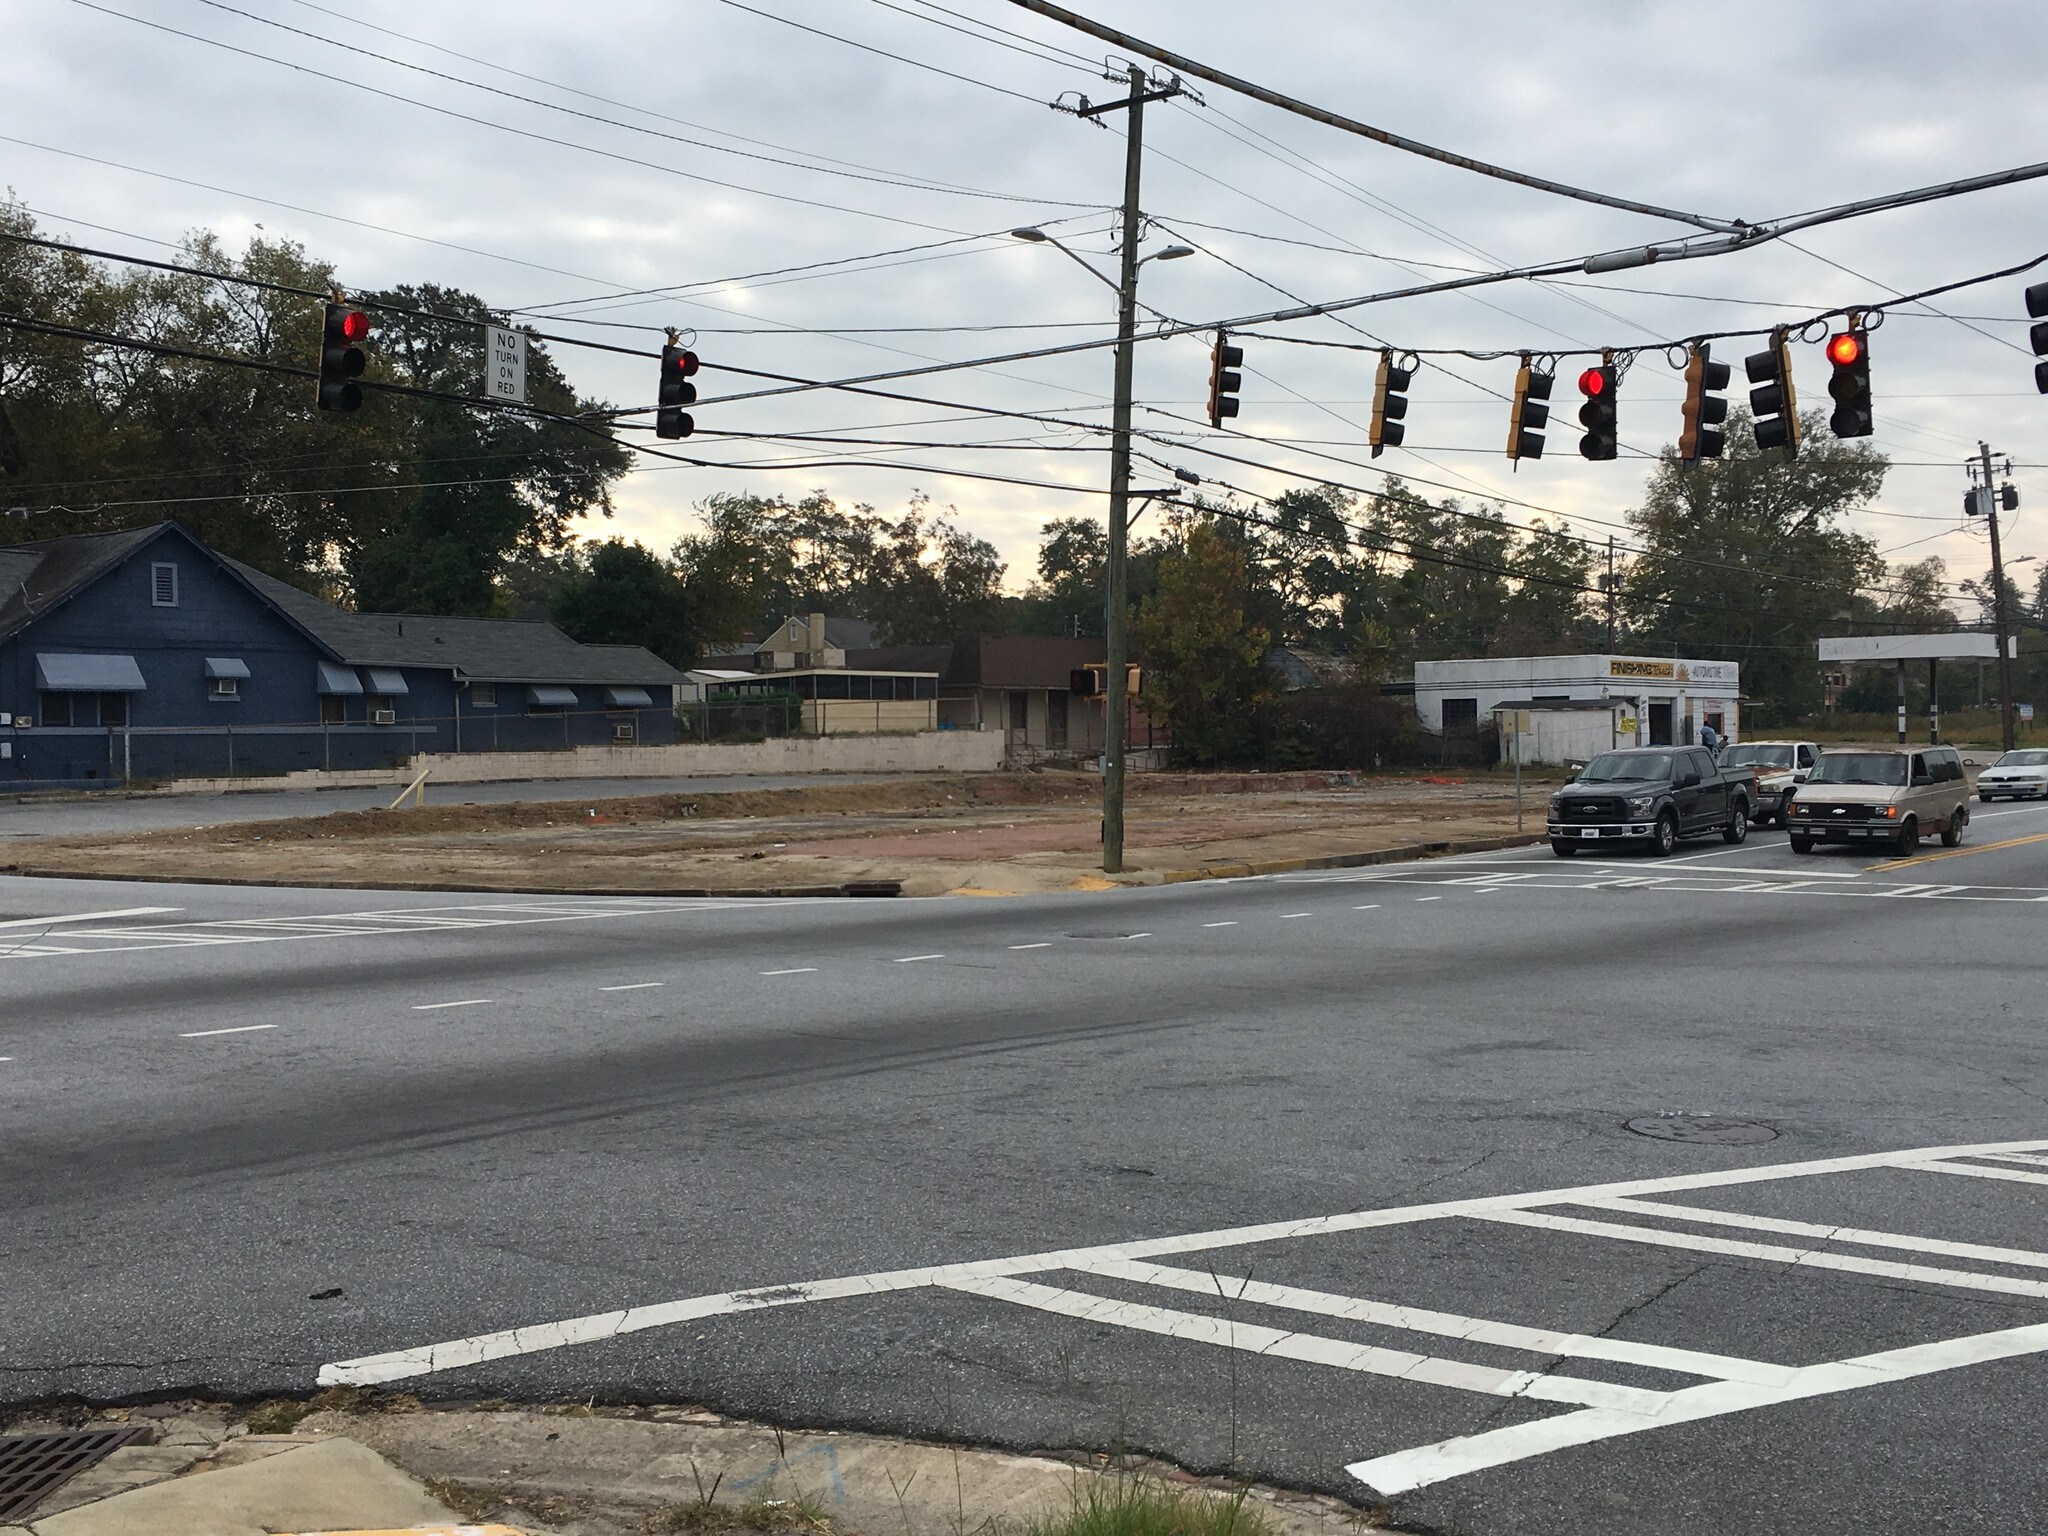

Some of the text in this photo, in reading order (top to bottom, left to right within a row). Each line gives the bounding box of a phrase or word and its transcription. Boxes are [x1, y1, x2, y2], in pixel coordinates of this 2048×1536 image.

[497, 333, 516, 349] NO
[495, 349, 518, 365] TURN
[500, 366, 514, 379] ON
[497, 381, 515, 395] RED
[1611, 662, 1653, 675] FINISHING
